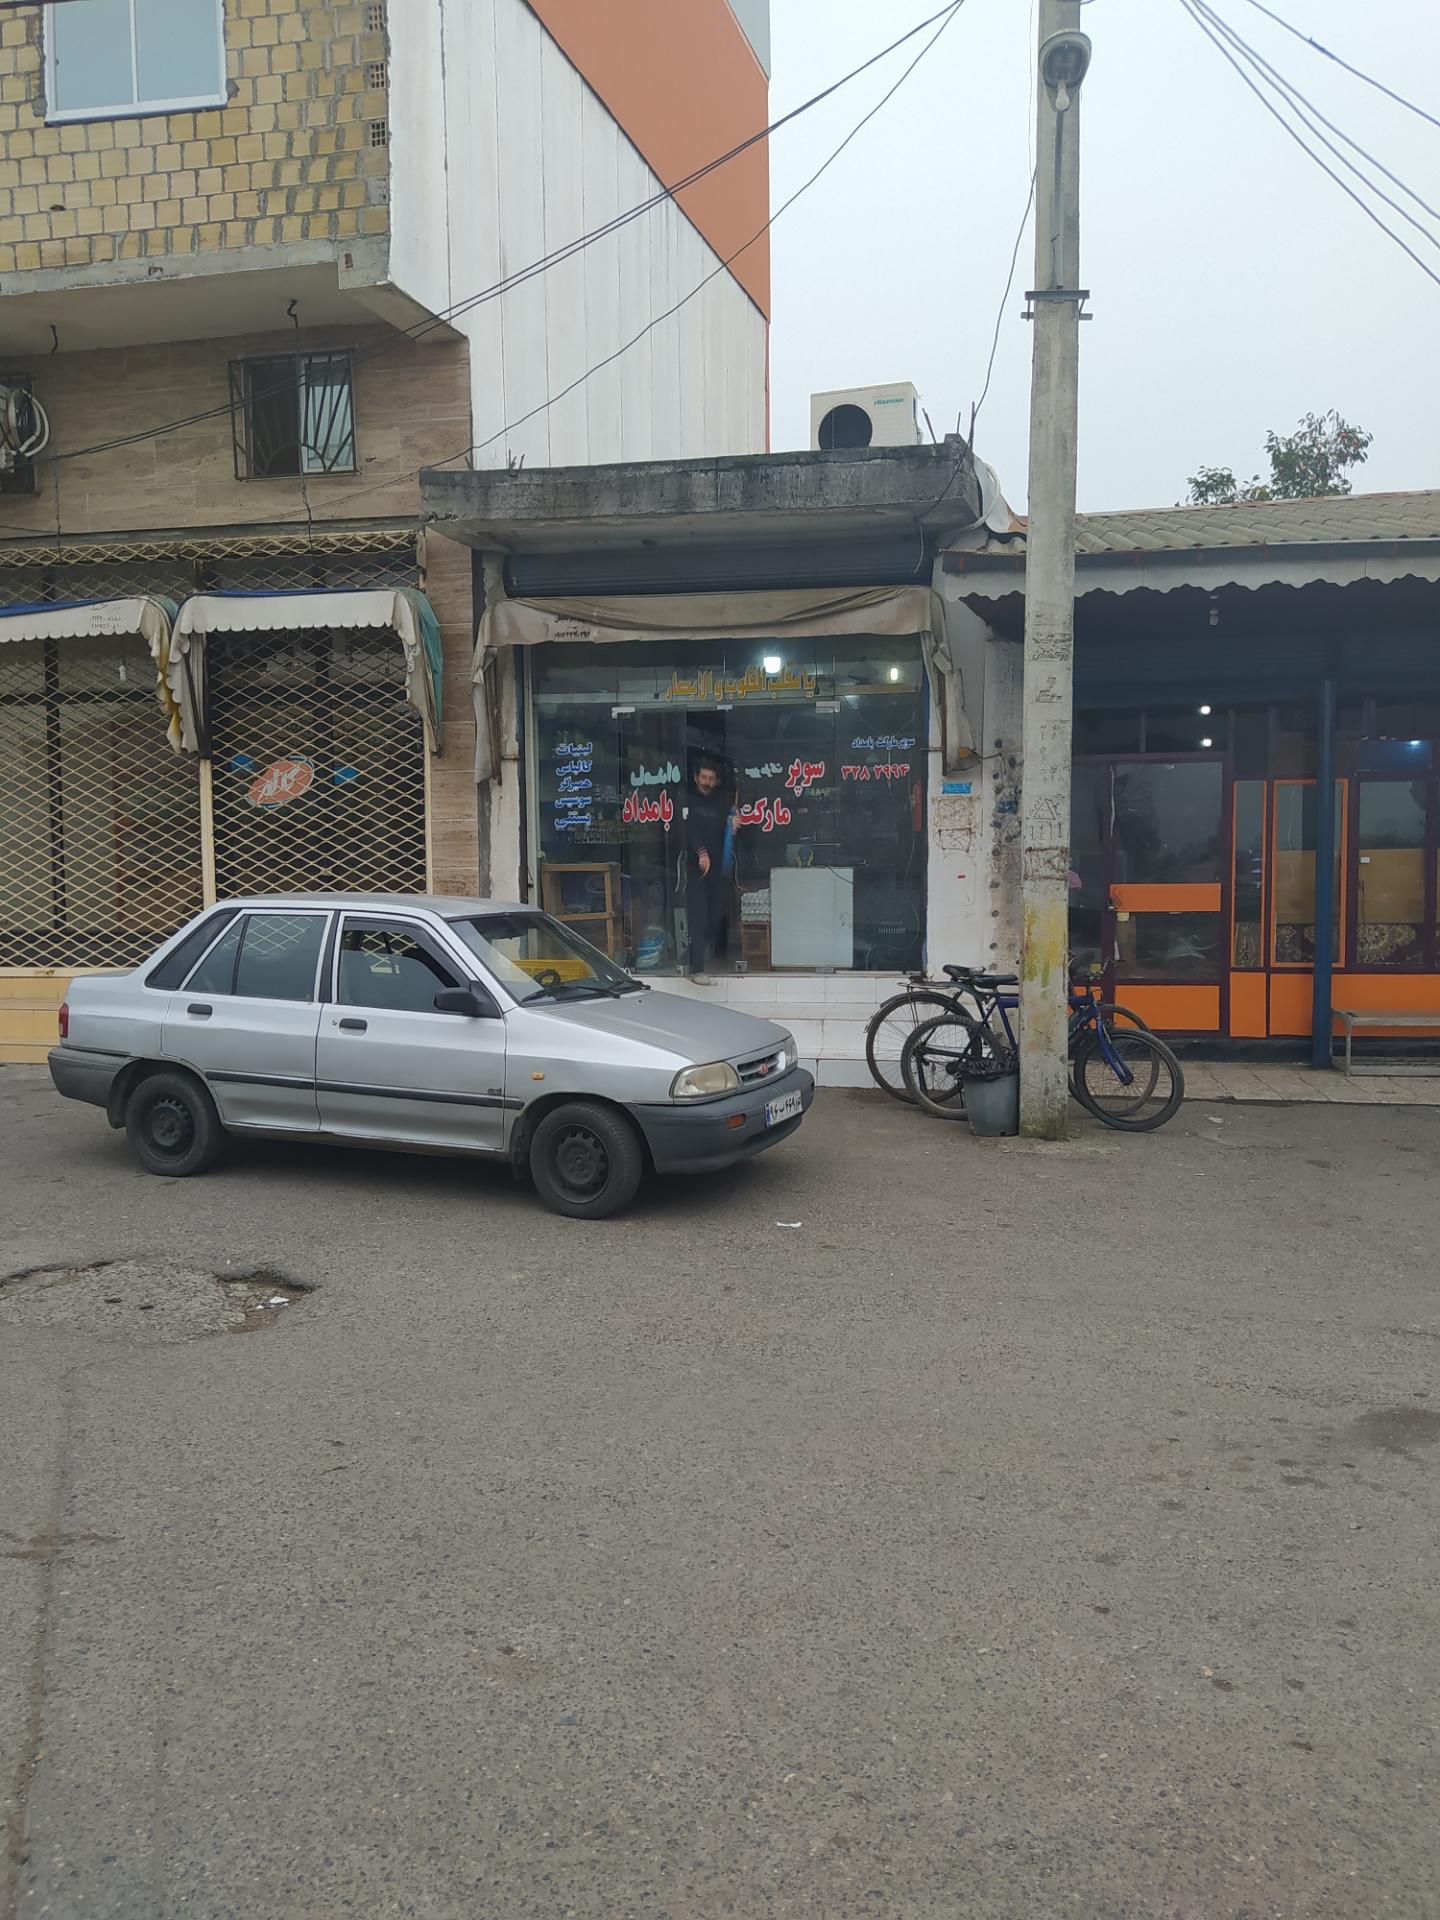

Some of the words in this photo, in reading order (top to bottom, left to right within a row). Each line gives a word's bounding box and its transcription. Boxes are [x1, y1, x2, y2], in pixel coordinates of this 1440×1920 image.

[556, 741, 593, 757] لبنیات
[785, 758, 826, 797] سوپر
[555, 796, 592, 808] سوسیس
[622, 789, 674, 832] بامداد
[739, 797, 791, 832] مارکت
[554, 811, 592, 828] بستنی
